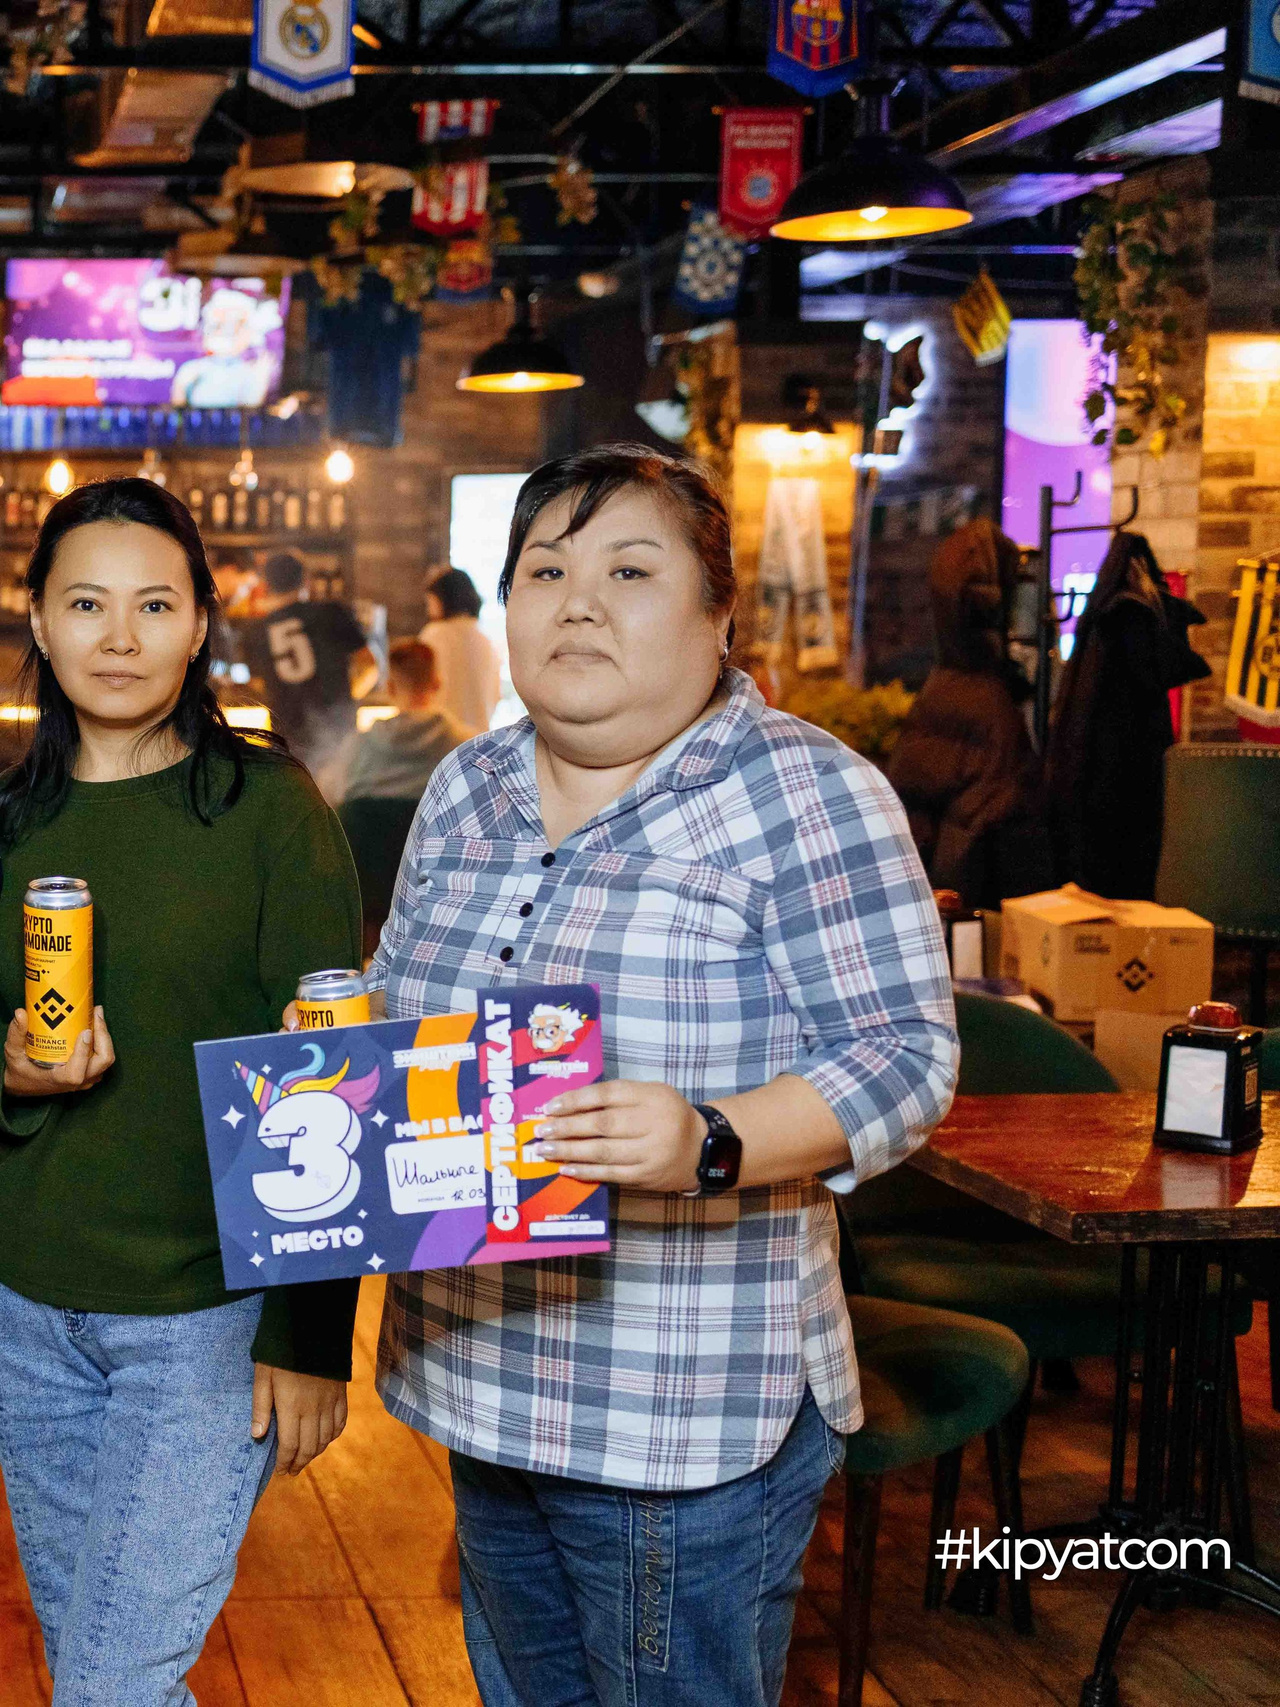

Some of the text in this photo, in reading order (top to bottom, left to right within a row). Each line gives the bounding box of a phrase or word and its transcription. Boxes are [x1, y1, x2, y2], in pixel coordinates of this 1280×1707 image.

[269, 618, 316, 684] 5
[24, 912, 53, 934] RYPTO
[25, 932, 72, 952] MONADE
[35, 1037, 67, 1046] BINANCE
[484, 999, 520, 1232] СЕРТИФИКАТ
[252, 1091, 362, 1222] 3
[271, 1225, 364, 1255] МЕСТО
